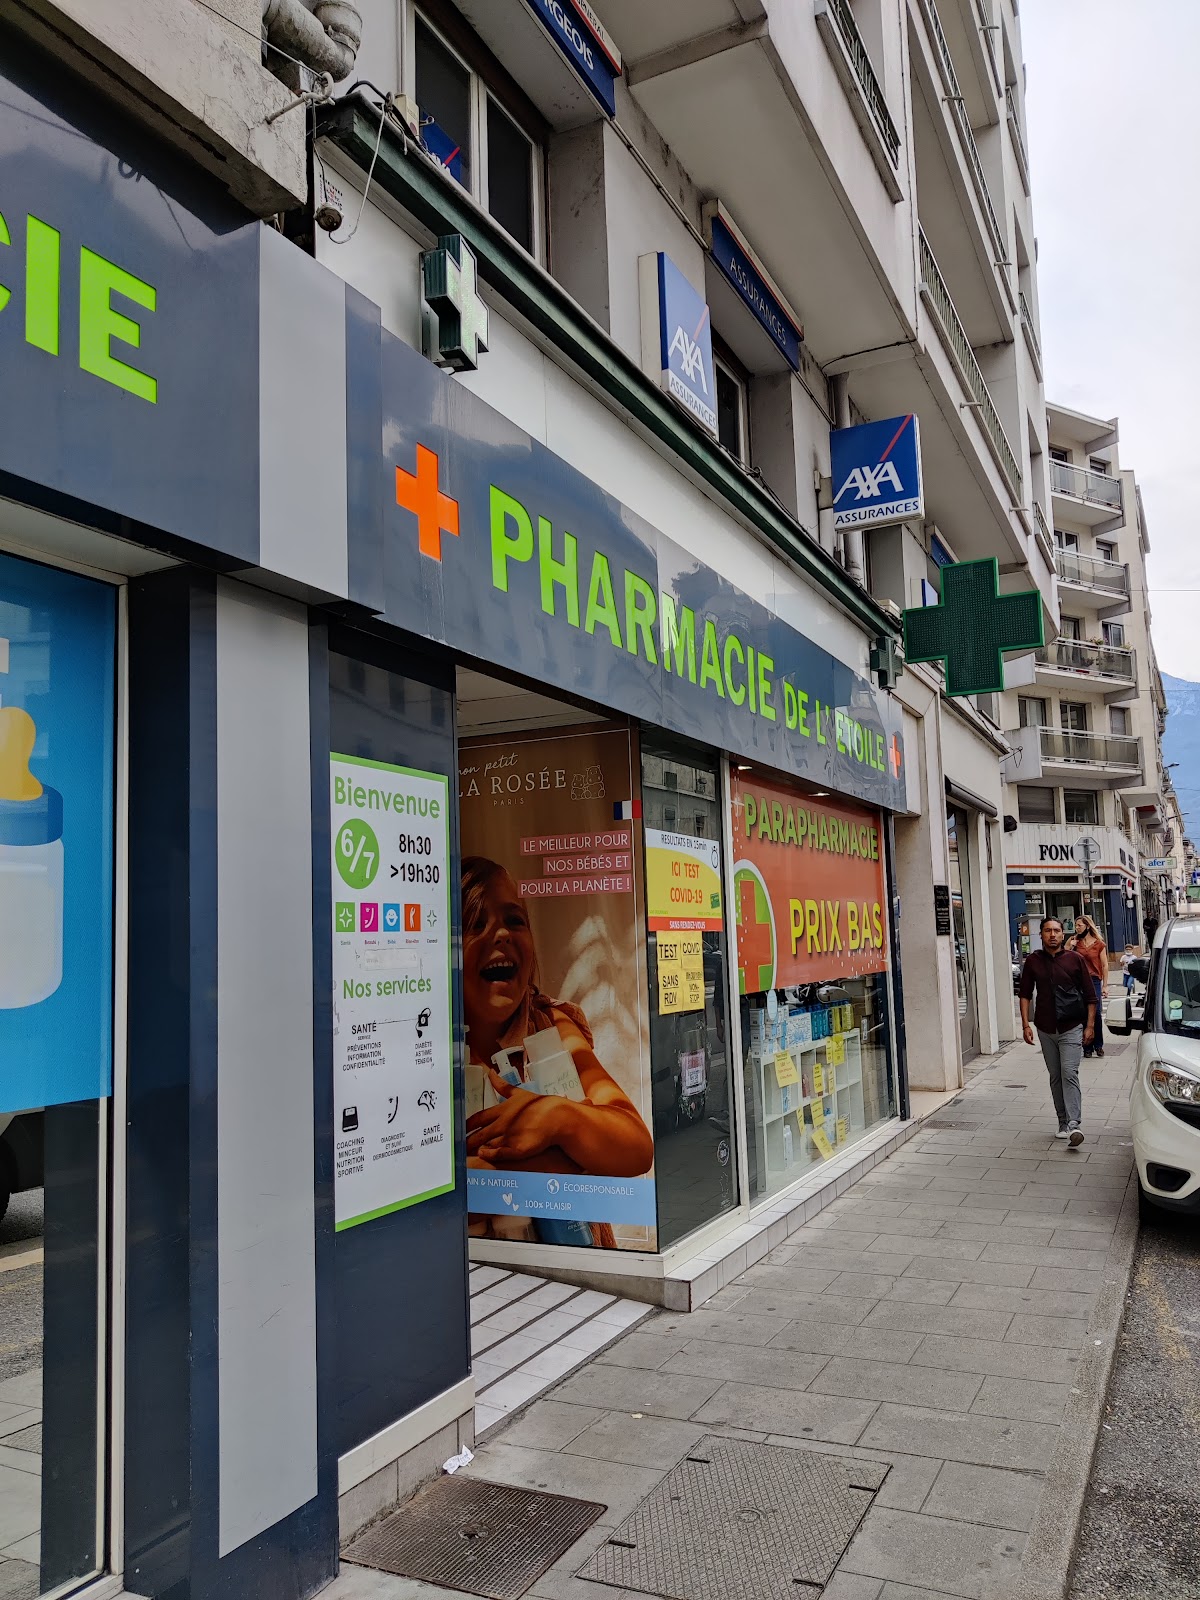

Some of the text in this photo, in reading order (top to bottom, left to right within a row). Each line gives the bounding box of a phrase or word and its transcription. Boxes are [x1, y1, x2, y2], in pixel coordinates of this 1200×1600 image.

[0, 211, 157, 404] IE
[730, 257, 787, 346] ASSURANCES
[667, 325, 709, 396] AXA
[670, 375, 717, 429] ASSURANCES
[832, 460, 905, 504] AXA
[835, 500, 919, 525] ASSURANCES
[489, 483, 776, 721] PHARMACIE
[783, 680, 811, 738] DE
[484, 752, 519, 777] petit
[490, 766, 567, 796] ROSÉE
[334, 776, 441, 819] Bienvenue
[493, 797, 525, 807] PARIS
[743, 792, 879, 861] PARAPHARMACIE
[399, 833, 431, 856] 8h30
[523, 833, 628, 853] LE MEILLEUR POUR
[340, 828, 375, 879] 6/7
[1147, 858, 1166, 867] afer
[546, 854, 629, 872] NOS BÉBÉS ET
[671, 861, 700, 879] ICI TEST
[390, 863, 440, 884] >19h30
[520, 881, 553, 895] POUR
[556, 881, 570, 894] LA
[573, 876, 623, 893] PLANÈTE
[670, 887, 703, 904] COVID-19
[789, 898, 843, 955] PRIX
[847, 901, 883, 950] BAS
[658, 942, 701, 959] TEST COVID
[343, 975, 432, 1000] Nos services
[662, 974, 679, 988] SANS
[351, 1020, 377, 1035] SANTÉ
[346, 1041, 382, 1053] PRÉVENTIONS
[347, 1050, 382, 1062] INFORMATION
[342, 1057, 386, 1072] CONFIDENTIALITÉ
[415, 1056, 433, 1065] TENSION
[380, 1132, 406, 1144] DIAGNOSTIC
[423, 1123, 441, 1136] SANTÉ
[336, 1136, 365, 1150] COACHING
[420, 1133, 444, 1148] ANIMALE
[338, 1146, 363, 1159] MINCEUR
[336, 1155, 365, 1169] NUTRITION
[337, 1164, 364, 1178] SPORTIVE
[480, 1178, 486, 1186] &
[487, 1178, 519, 1188] NATUREL
[563, 1181, 634, 1196] ÉCORESPONSABLE
[524, 1199, 572, 1211] 100% PLAISIR
